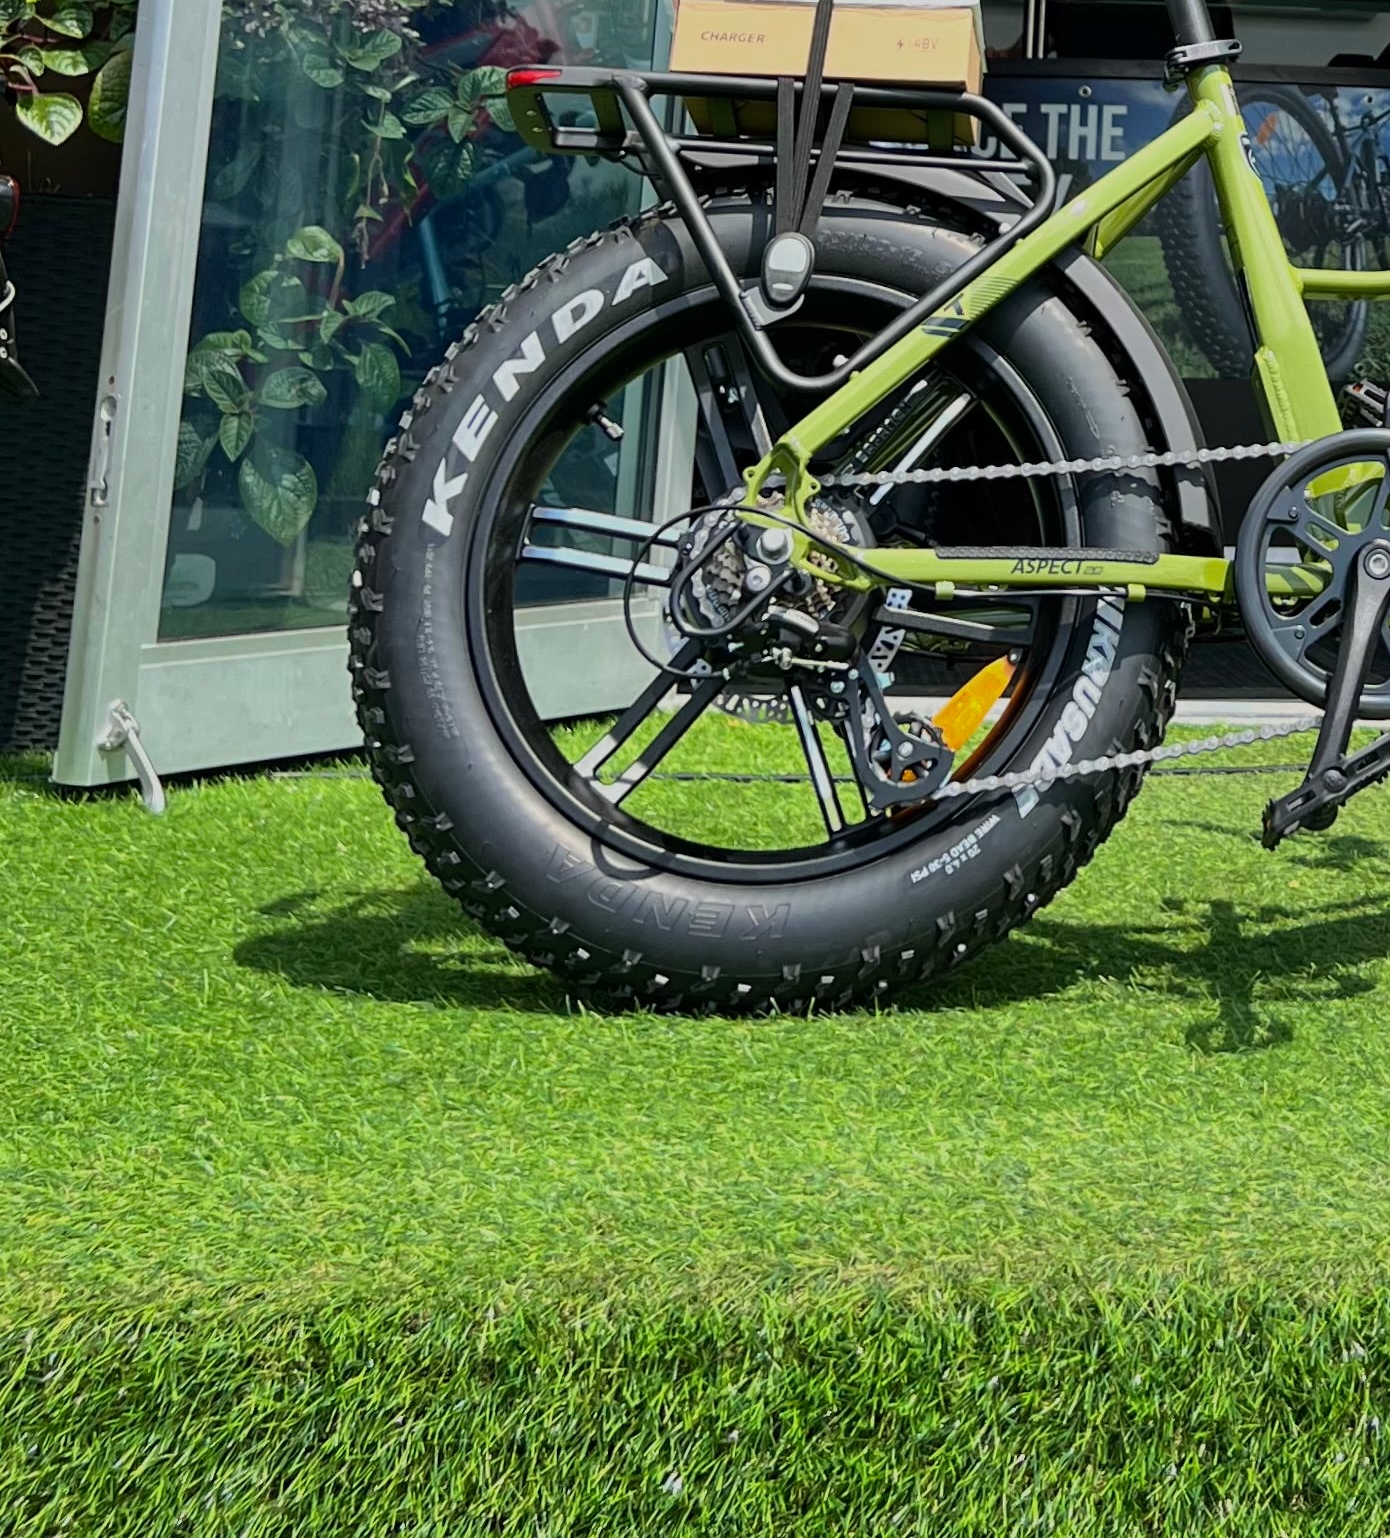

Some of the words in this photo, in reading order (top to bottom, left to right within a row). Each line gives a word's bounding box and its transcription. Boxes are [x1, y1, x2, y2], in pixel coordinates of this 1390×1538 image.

[700, 30, 766, 45] CHARGER
[1040, 103, 1128, 161] THE
[422, 257, 669, 537] KENDA
[1010, 559, 1084, 575] ASPECT
[949, 833, 978, 858] BEAD
[544, 843, 791, 941] KENDA
